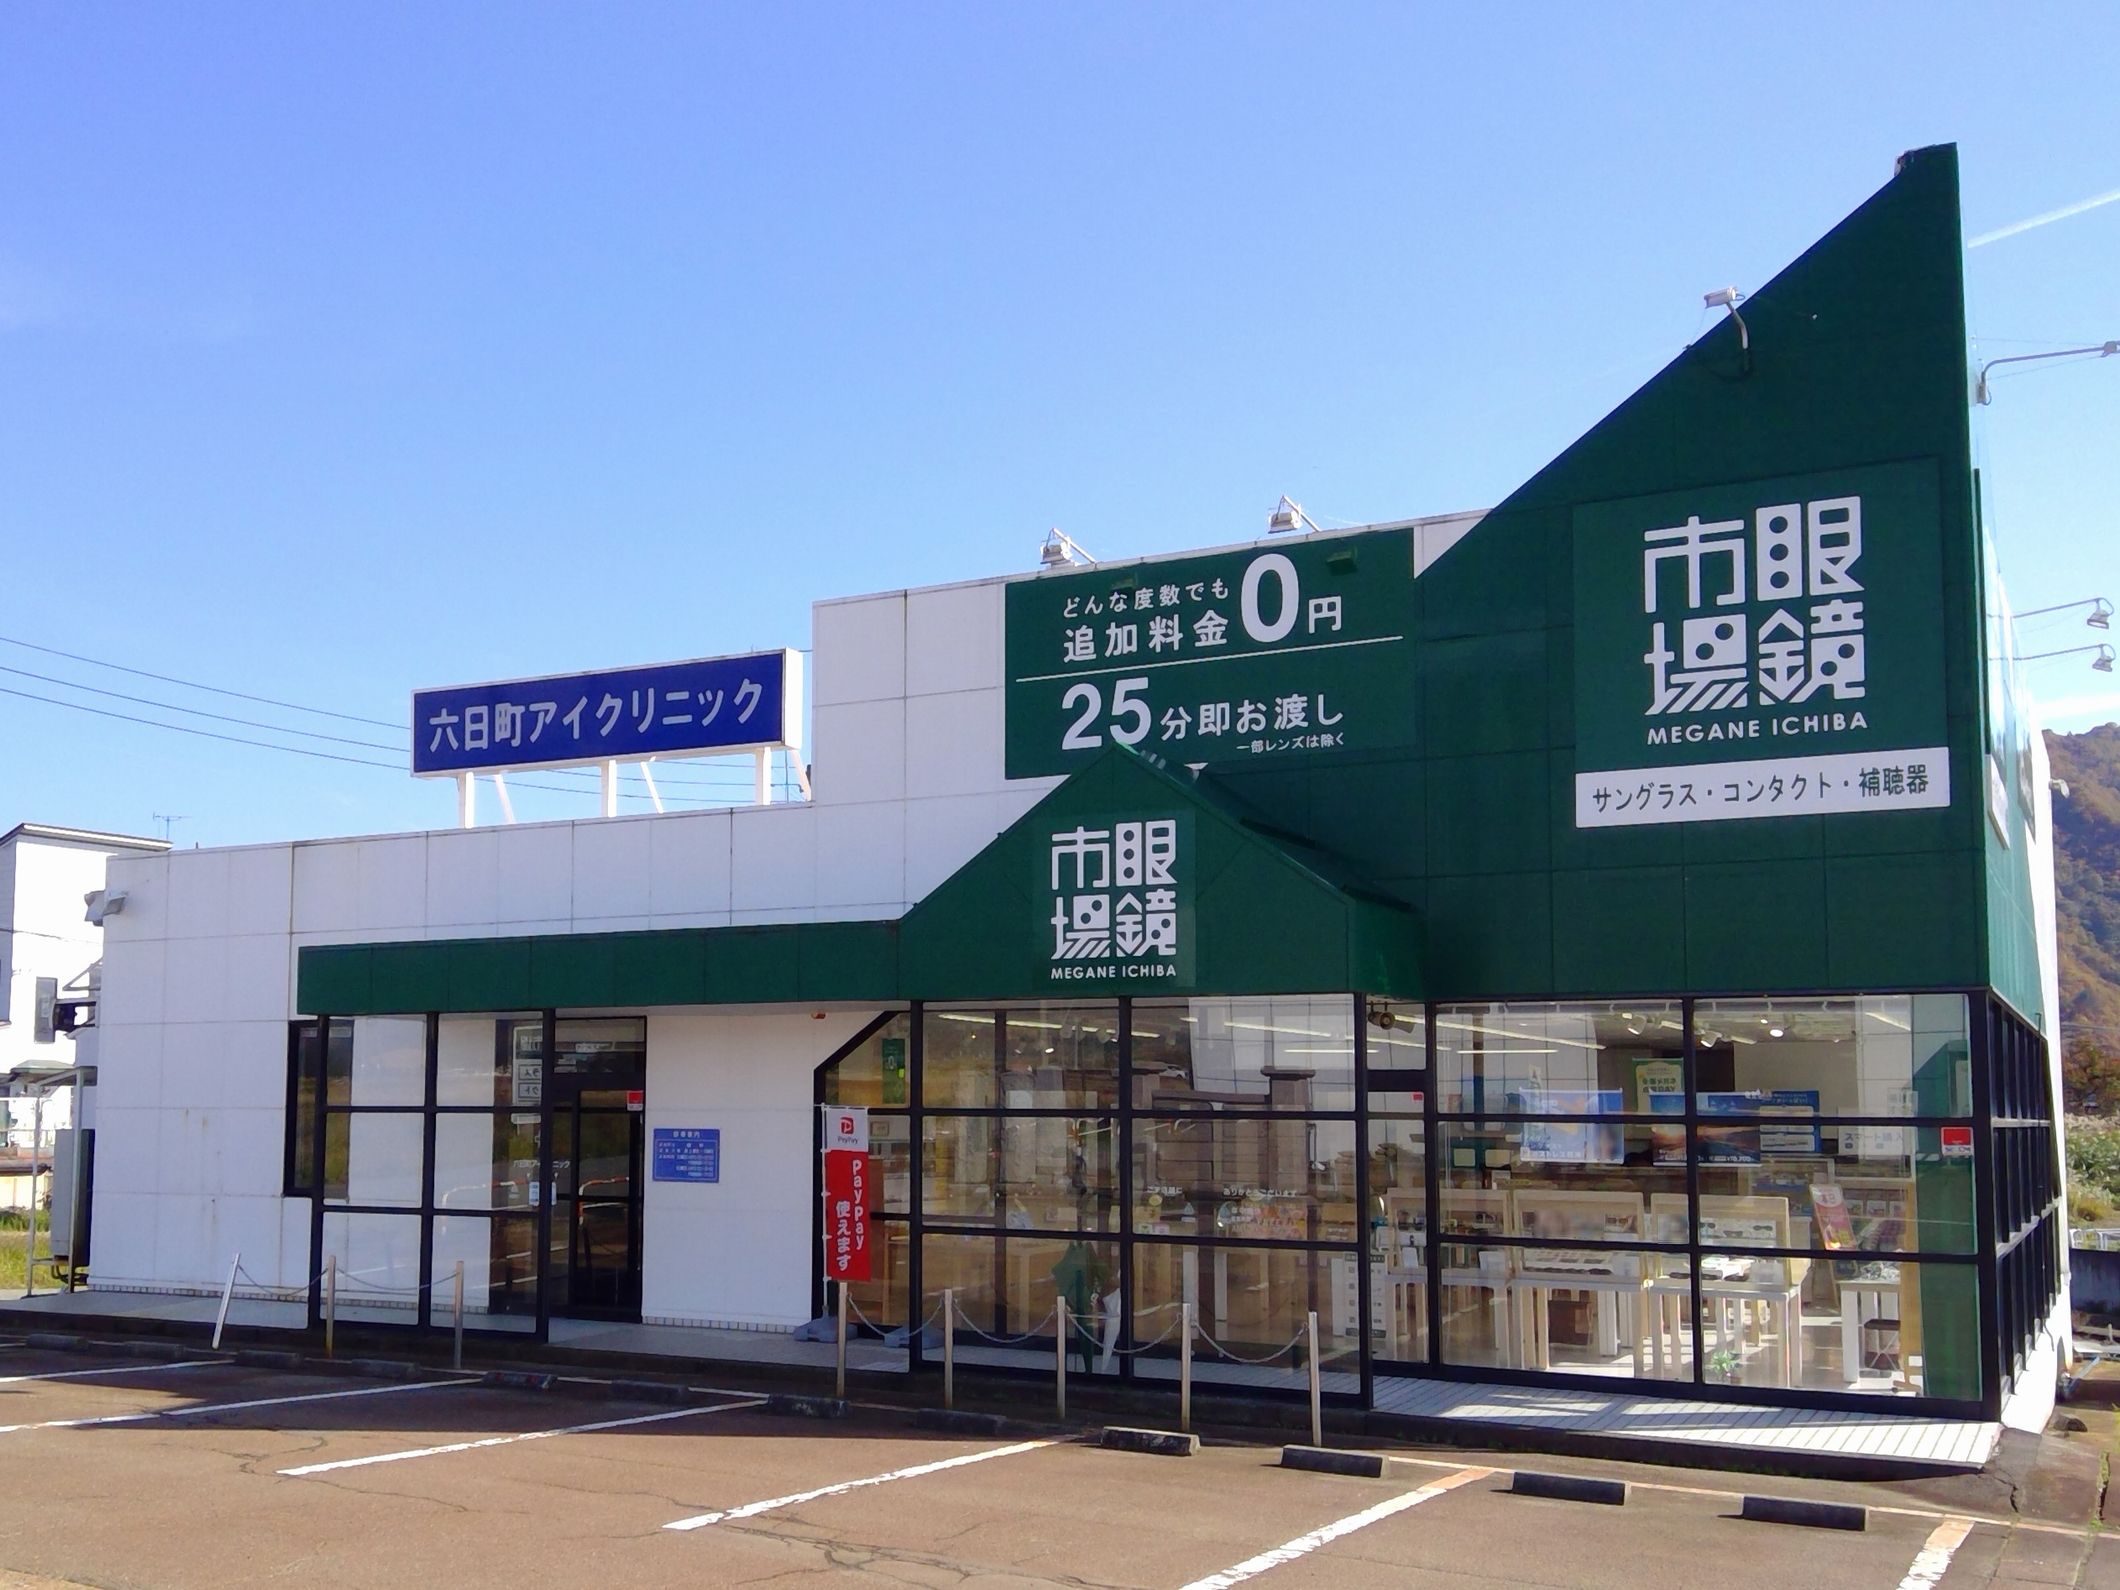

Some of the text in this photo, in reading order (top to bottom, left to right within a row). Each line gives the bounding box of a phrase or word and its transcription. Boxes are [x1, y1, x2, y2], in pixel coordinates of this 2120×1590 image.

[1063, 578, 1229, 618] どんな度数でも
[428, 677, 763, 753] 六日町アイクリニック
[1061, 676, 1344, 751] 25分即お渡し
[1646, 711, 1868, 745] MEGANE ICHIBA
[1236, 732, 1345, 755] 一部レンズは除く
[1592, 763, 1929, 813] サングラス・コンタクト・補聴器
[1050, 964, 1177, 980] MEGANE ICHIBA
[852, 1159, 864, 1250] PayPay
[835, 1200, 852, 1271] 使えます
